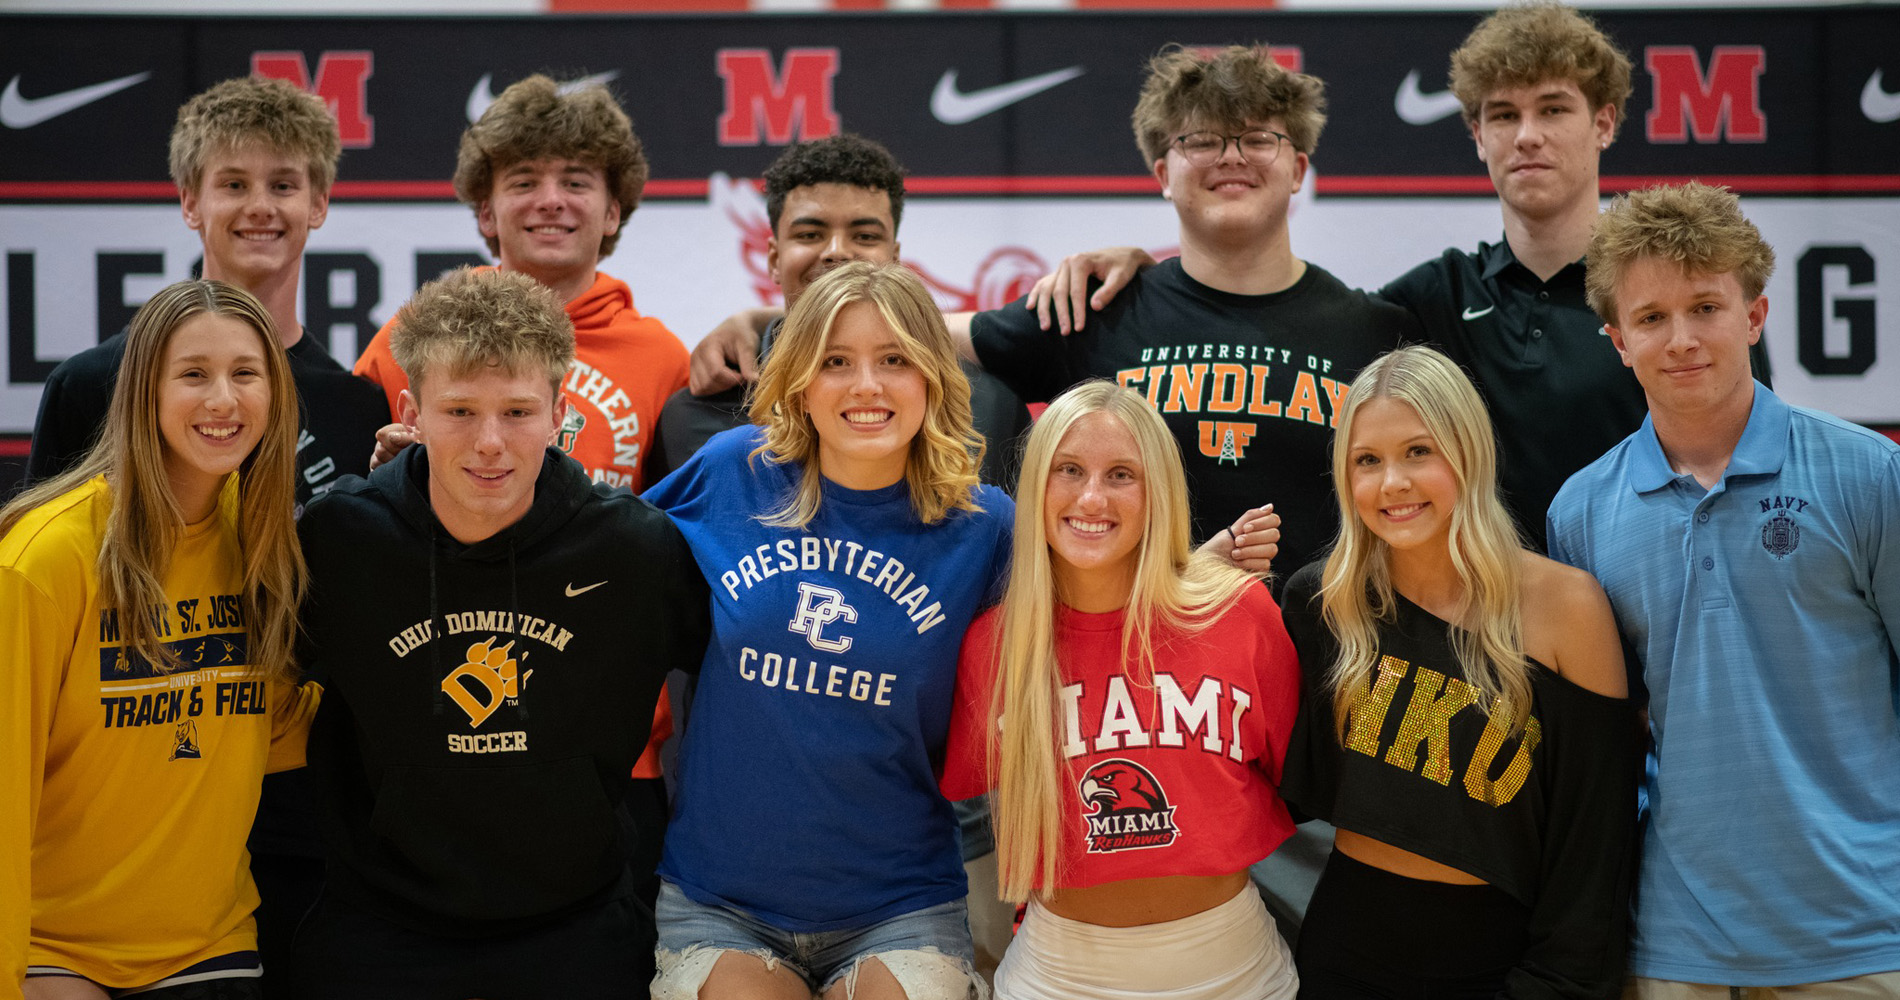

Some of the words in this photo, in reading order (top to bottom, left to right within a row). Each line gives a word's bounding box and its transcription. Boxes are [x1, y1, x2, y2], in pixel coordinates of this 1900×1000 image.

[717, 48, 840, 145] M
[1646, 46, 1767, 143] M
[1141, 344, 1291, 364] UNIVERSITY
[1307, 355, 1332, 373] OF
[566, 360, 640, 468] THERN
[1116, 363, 1350, 429] FINDLAY
[1198, 421, 1257, 462] UF
[1759, 496, 1809, 513] NAVY
[721, 537, 946, 634] PRESBYTERIAN
[177, 599, 201, 633] ST.
[445, 611, 574, 651] DOMINICAN
[739, 647, 897, 706] COLLEGE
[101, 688, 184, 728] TRACK
[188, 686, 203, 716] &
[506, 699, 518, 707] TM
[997, 672, 1251, 764] IAMI
[448, 731, 528, 753] SOCCER
[1344, 654, 1542, 808] NKU
[1091, 811, 1172, 836] MIAMI
[1094, 832, 1172, 850] REDHAWKS
